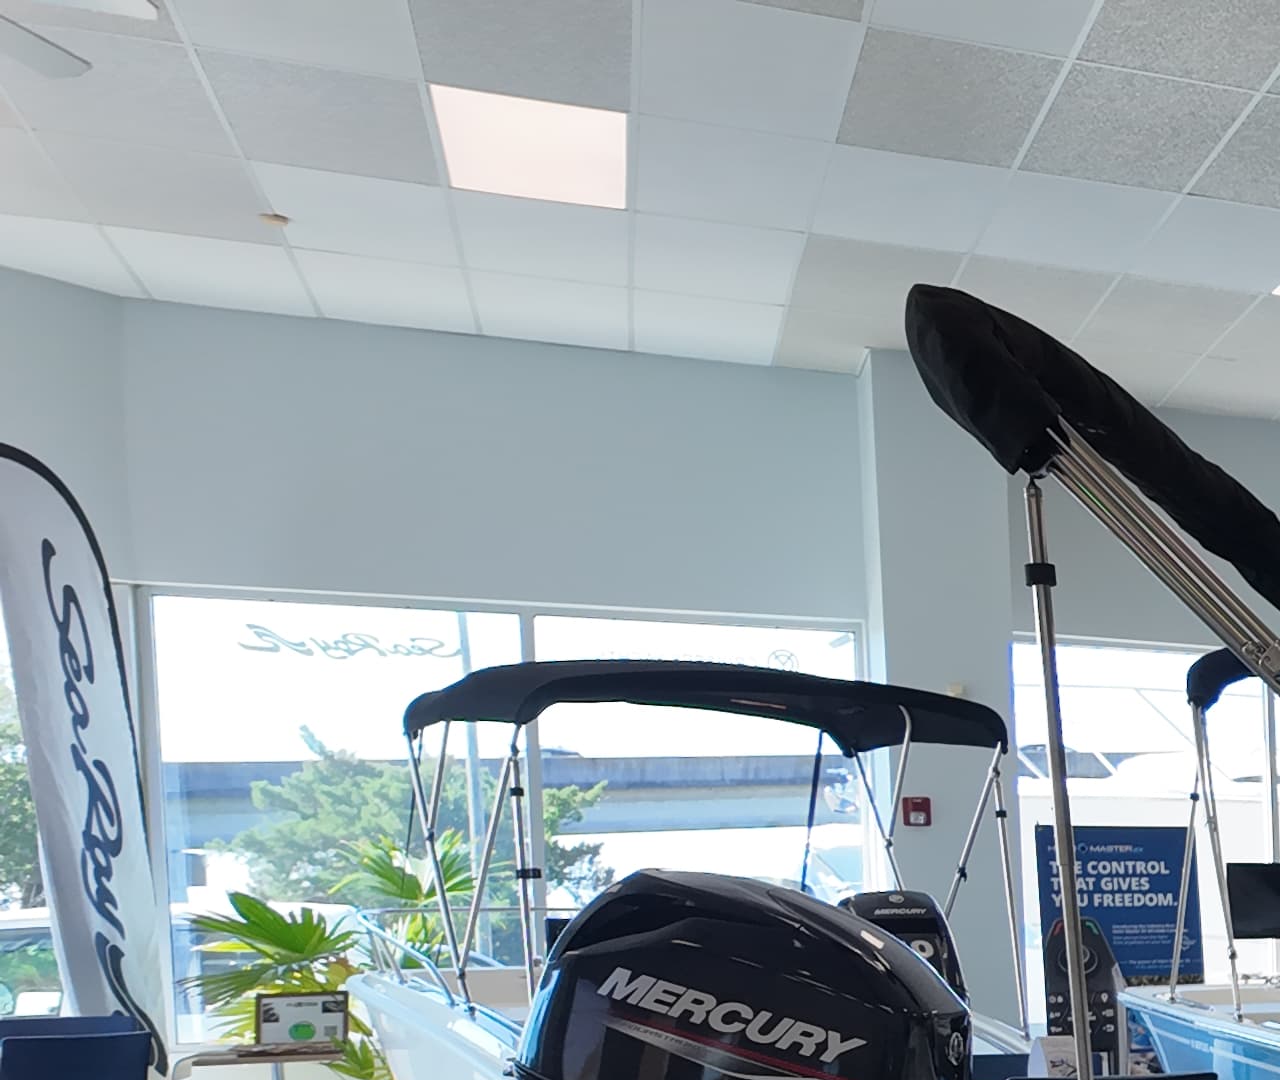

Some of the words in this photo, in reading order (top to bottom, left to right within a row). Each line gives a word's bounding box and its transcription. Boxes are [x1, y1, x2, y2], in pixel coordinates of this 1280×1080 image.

[41, 537, 94, 755] Sea
[71, 743, 125, 940] Ray
[1049, 861, 1082, 874] TE
[1087, 861, 1169, 874] CONTROL
[1051, 877, 1096, 890] TAT
[1100, 877, 1149, 890] GIVES
[1052, 893, 1088, 906] YU
[1094, 893, 1178, 906] FREEDOM.
[597, 967, 867, 1063] MERCURY
